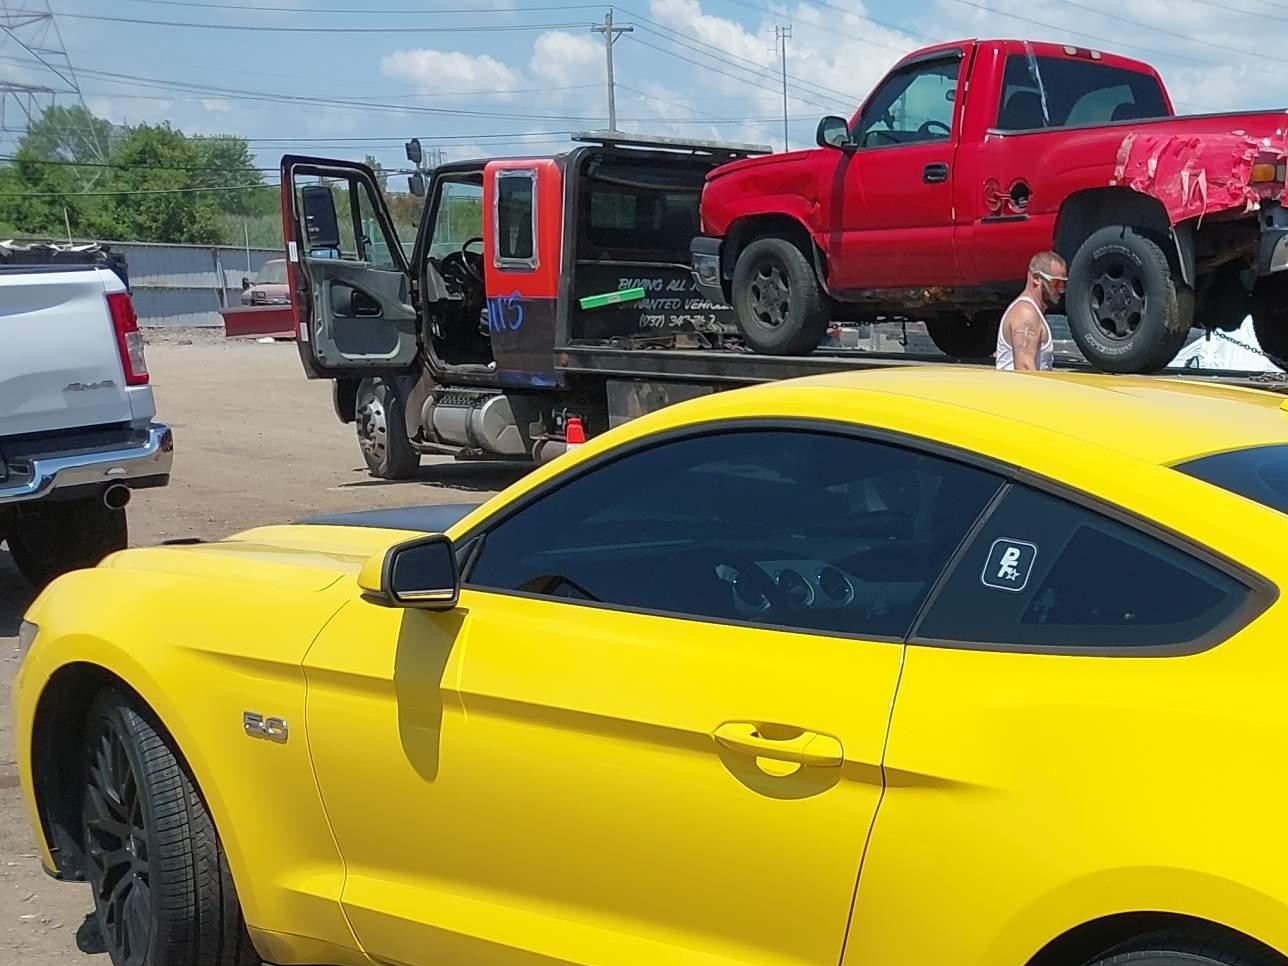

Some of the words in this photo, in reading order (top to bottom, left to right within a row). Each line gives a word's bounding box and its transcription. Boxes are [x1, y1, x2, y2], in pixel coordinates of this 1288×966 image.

[618, 278, 663, 291] BUYING
[666, 279, 686, 291] ALL
[243, 711, 288, 744] 5.0
